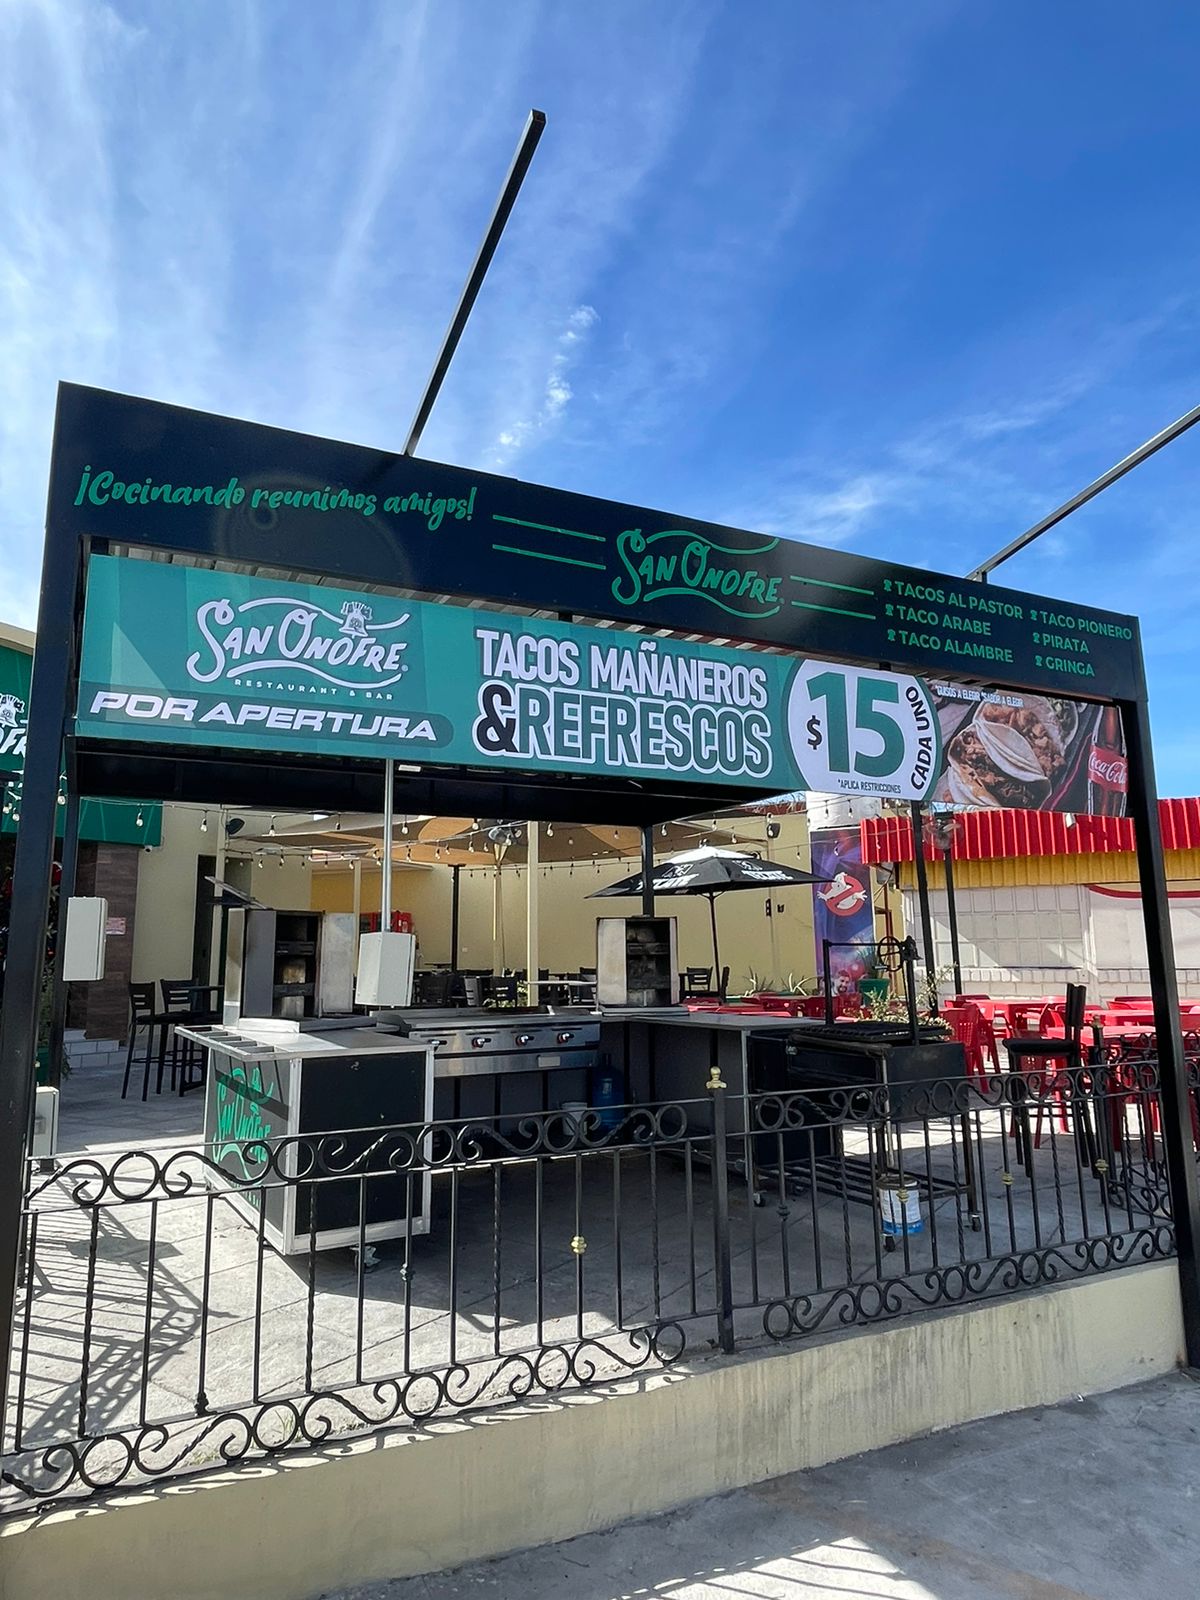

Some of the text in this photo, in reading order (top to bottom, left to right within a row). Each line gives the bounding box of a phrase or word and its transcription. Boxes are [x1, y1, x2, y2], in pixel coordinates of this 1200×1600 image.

[384, 486, 477, 532] amigos!
[895, 580, 1023, 620] TACOS AL PASTOR
[897, 605, 992, 636] TACO ARABE
[1040, 610, 1132, 640] TACO PIONERO
[899, 630, 1014, 663] TACO ALAMBRE
[1042, 633, 1089, 654] PIRATA
[476, 629, 768, 709] TACOS MAÑANEROS
[1045, 656, 1095, 677] GRINGA
[234, 678, 337, 695] RESTAURANT
[365, 691, 393, 700] BAR
[90, 690, 437, 742] POR APERTURA
[905, 686, 932, 790] CADA UNO
